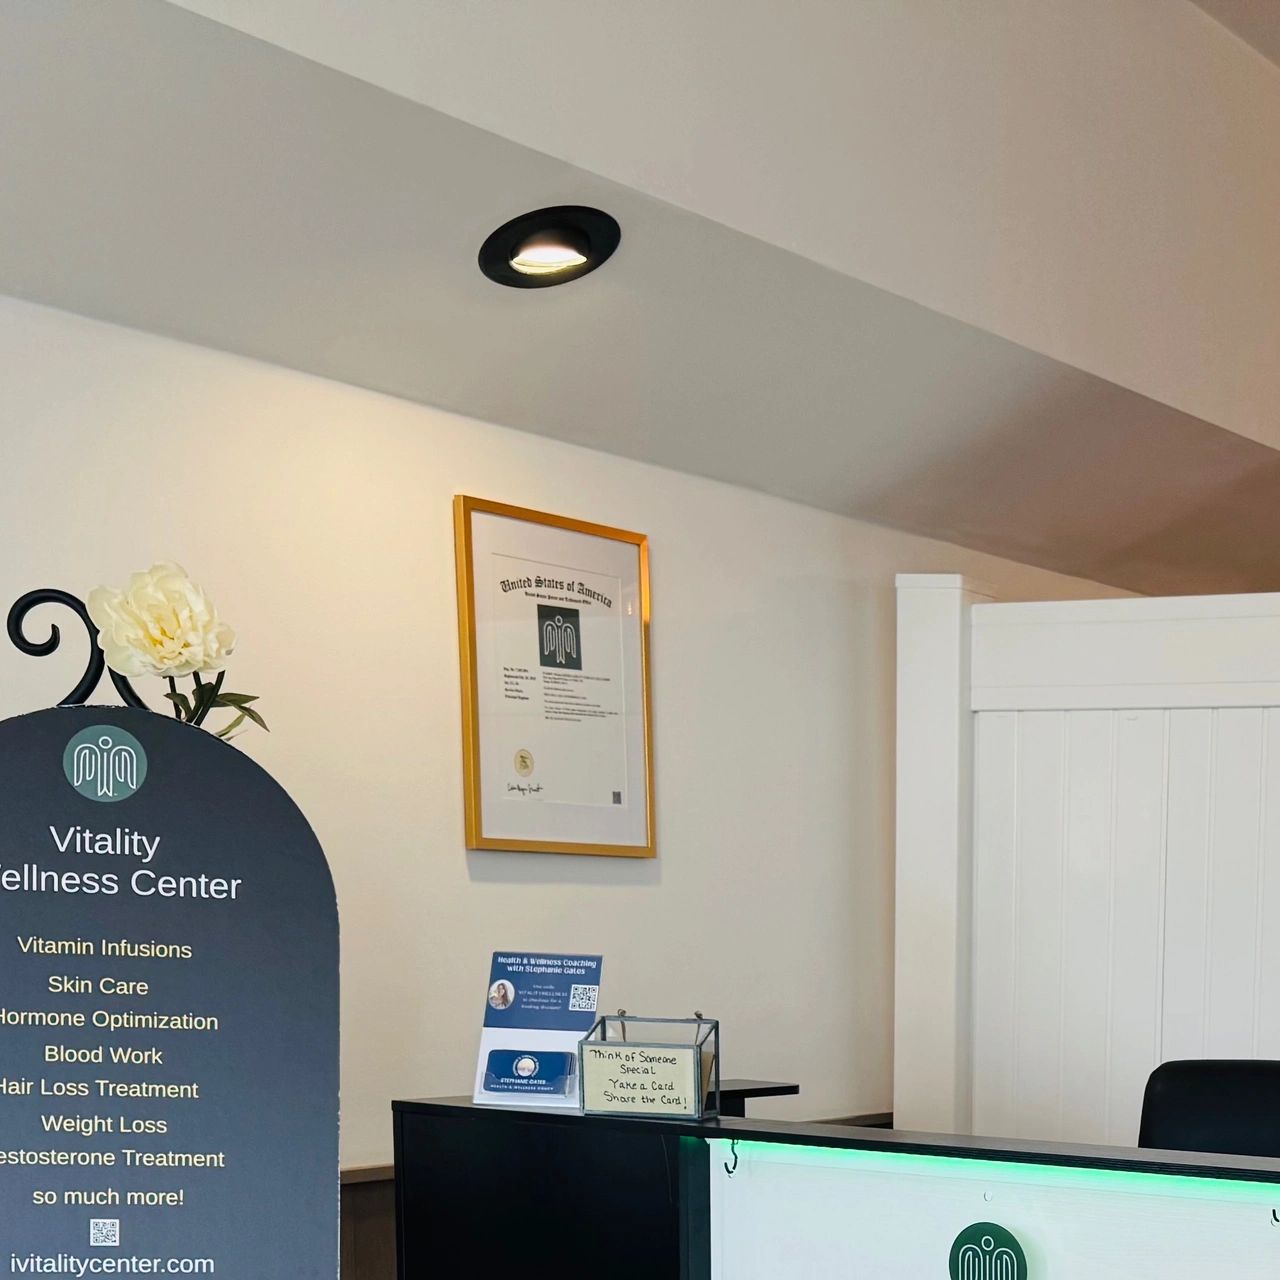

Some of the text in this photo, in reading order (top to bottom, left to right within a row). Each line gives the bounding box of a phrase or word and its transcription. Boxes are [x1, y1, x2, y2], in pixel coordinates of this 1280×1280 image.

[500, 577, 532, 593] United
[534, 576, 565, 590] States
[567, 580, 575, 592] of
[577, 582, 612, 608] America
[49, 825, 161, 863] Vitality
[0, 863, 242, 899] ellness Center
[17, 936, 192, 959] Vitamin Infusions
[525, 965, 563, 974] Stephanie
[563, 966, 586, 975] Gates
[563, 959, 597, 969] Coaching
[48, 976, 149, 995] Skin Care
[92, 1010, 219, 1031] Optimization
[44, 1045, 163, 1065] Blood Work
[625, 1051, 636, 1062] of
[639, 1051, 677, 1065] Someone
[41, 1079, 89, 1096] Loss
[95, 1080, 199, 1099] Treatment
[651, 1081, 674, 1091] Card
[641, 1095, 656, 1104] the
[41, 1114, 168, 1136] Weight Loss
[0, 1149, 225, 1168] estosterone Treatment
[32, 1188, 184, 1206] so much more!
[10, 1253, 215, 1278] ivitalitycenter.com
